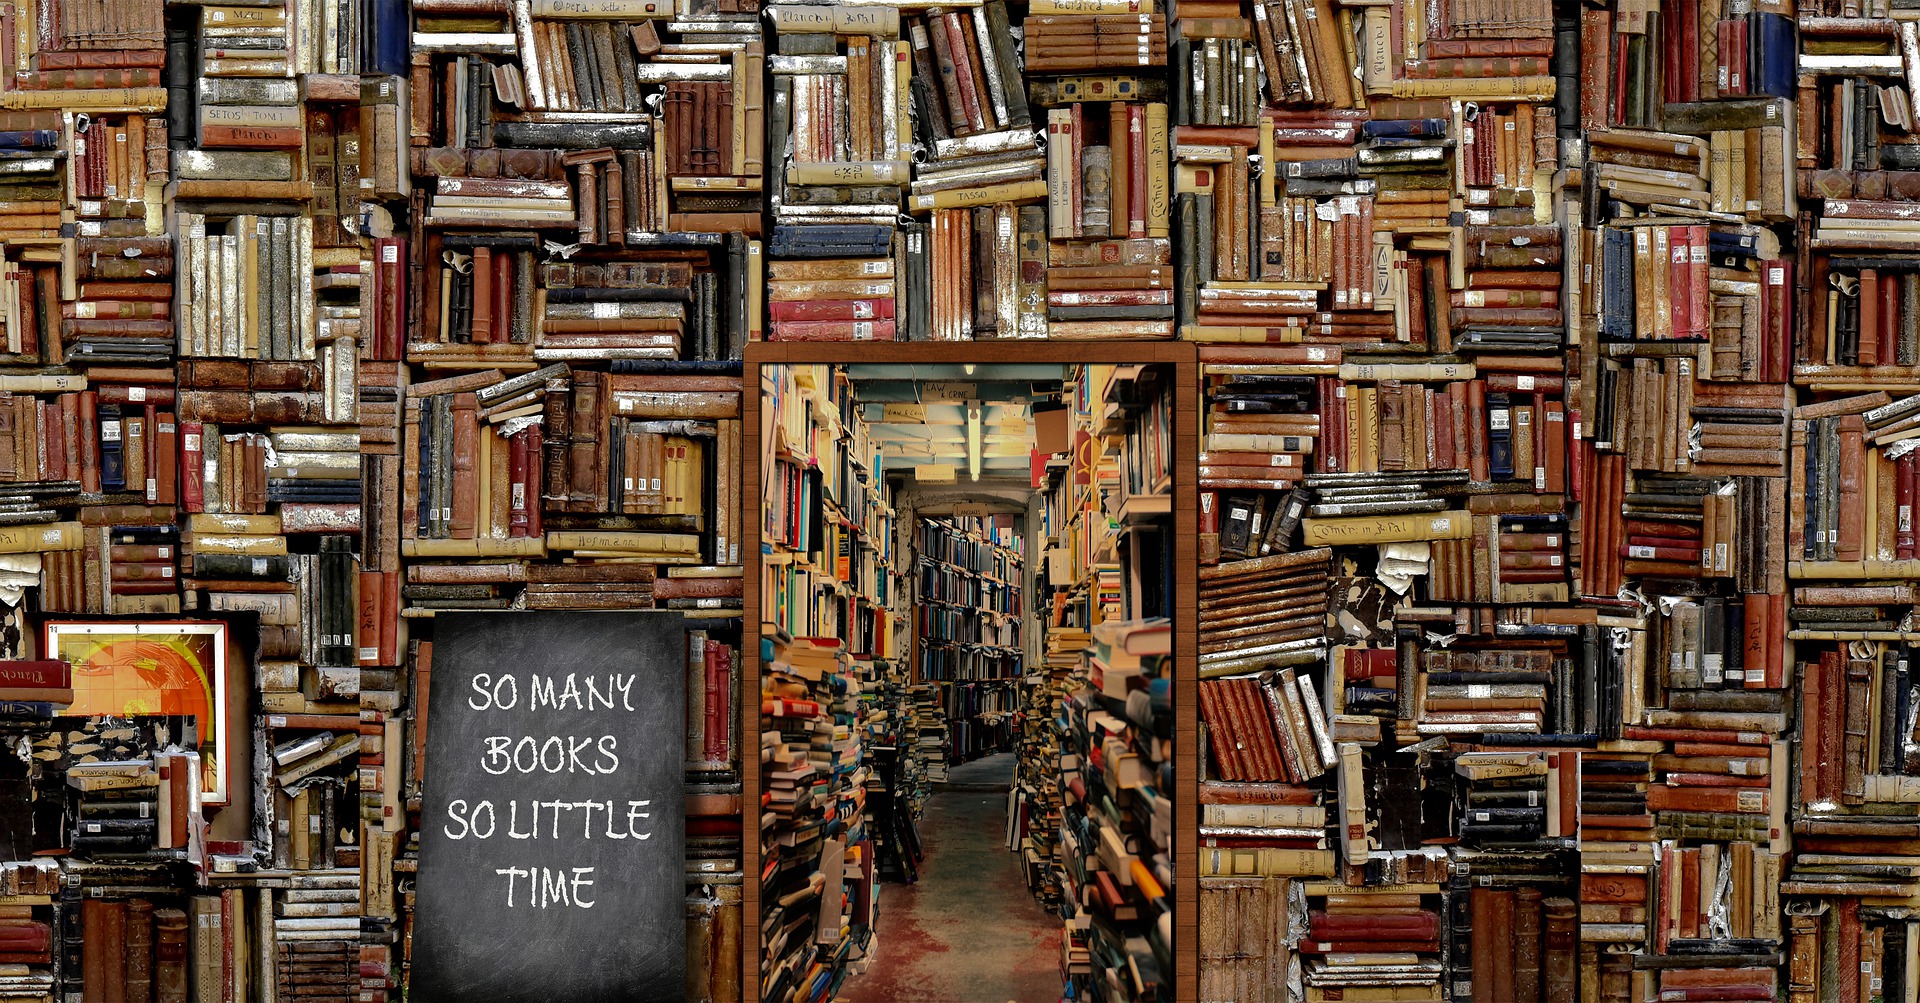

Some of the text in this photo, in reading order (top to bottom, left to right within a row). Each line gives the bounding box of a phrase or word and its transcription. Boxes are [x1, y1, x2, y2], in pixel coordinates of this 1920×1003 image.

[956, 191, 988, 201] TASSO
[926, 383, 945, 393] LAW
[469, 673, 635, 711] SO MANY
[481, 735, 618, 775] BOOKS
[444, 799, 651, 840] SO LITTLE
[496, 866, 594, 909] TIME
